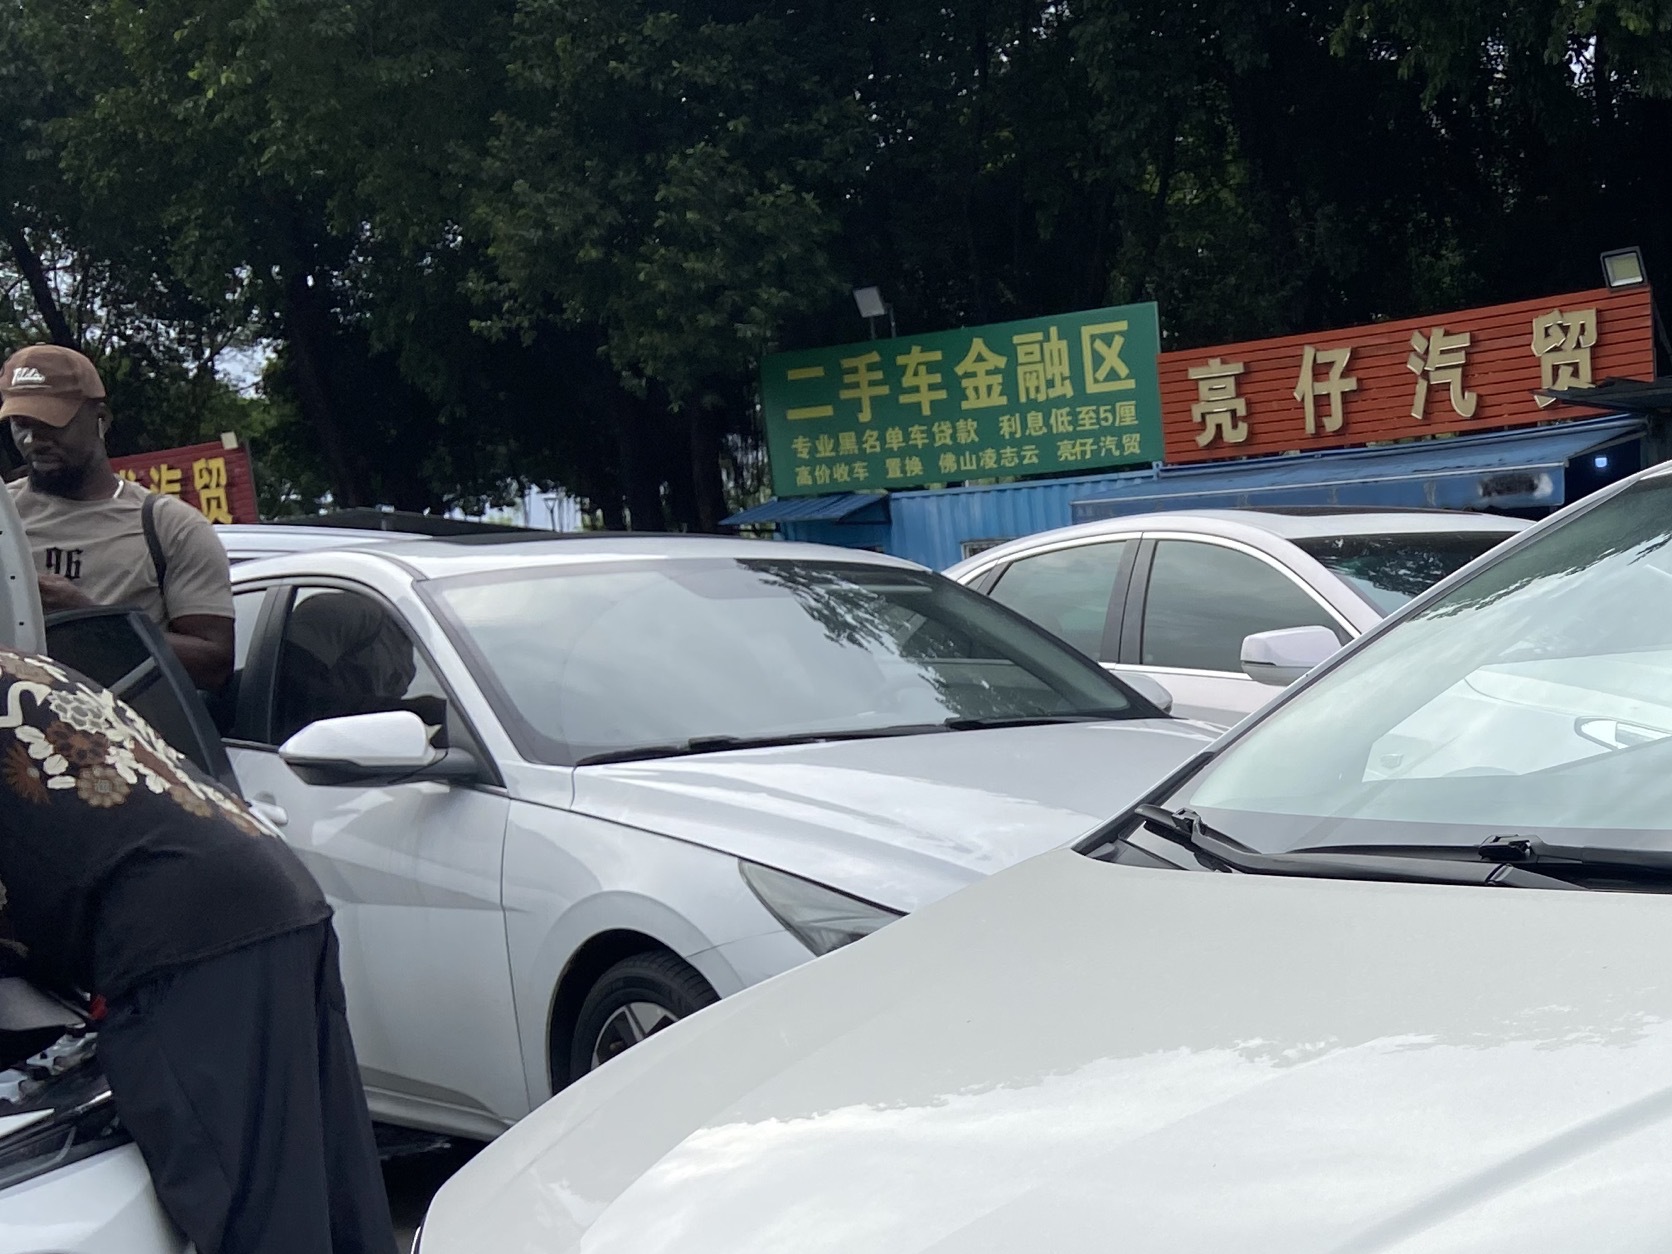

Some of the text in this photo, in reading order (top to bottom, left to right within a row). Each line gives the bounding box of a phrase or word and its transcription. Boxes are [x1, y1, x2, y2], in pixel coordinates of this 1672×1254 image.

[786, 319, 1137, 423] 二手车金融区
[1187, 307, 1599, 448] 亮仔汽贸
[791, 400, 1139, 460] 专业黑名单车贷款 利息低至5厘
[794, 460, 870, 488] 高价收车
[884, 455, 924, 480] 置换
[1056, 433, 1141, 462] 亮仔汽贸
